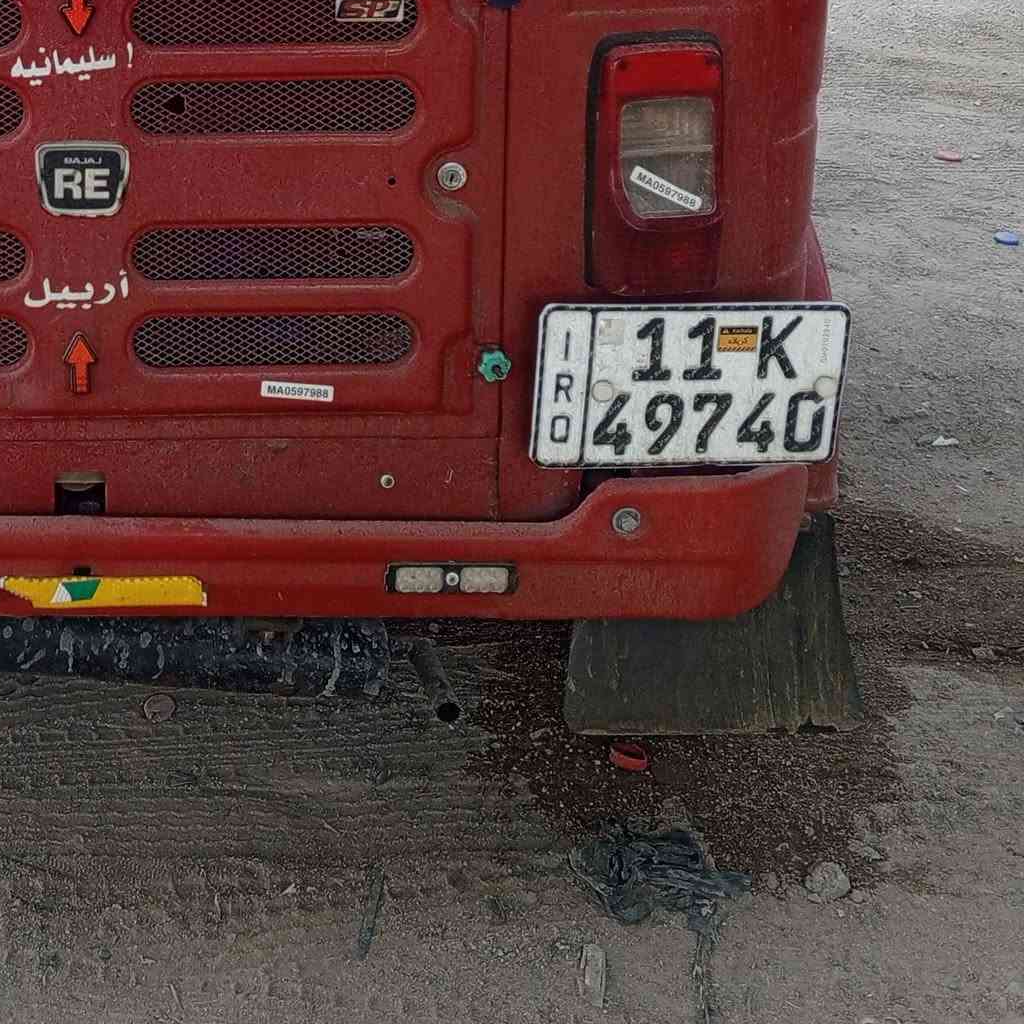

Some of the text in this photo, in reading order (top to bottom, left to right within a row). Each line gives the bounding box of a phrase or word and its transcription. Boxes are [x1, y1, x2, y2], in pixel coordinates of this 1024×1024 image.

[54, 168, 110, 199] RE
[637, 172, 697, 208] MA0597988
[24, 268, 129, 309] أربيل
[631, 317, 722, 381] 11
[757, 316, 804, 379] K
[267, 385, 329, 398] MA0597988
[592, 391, 826, 455] 49740
